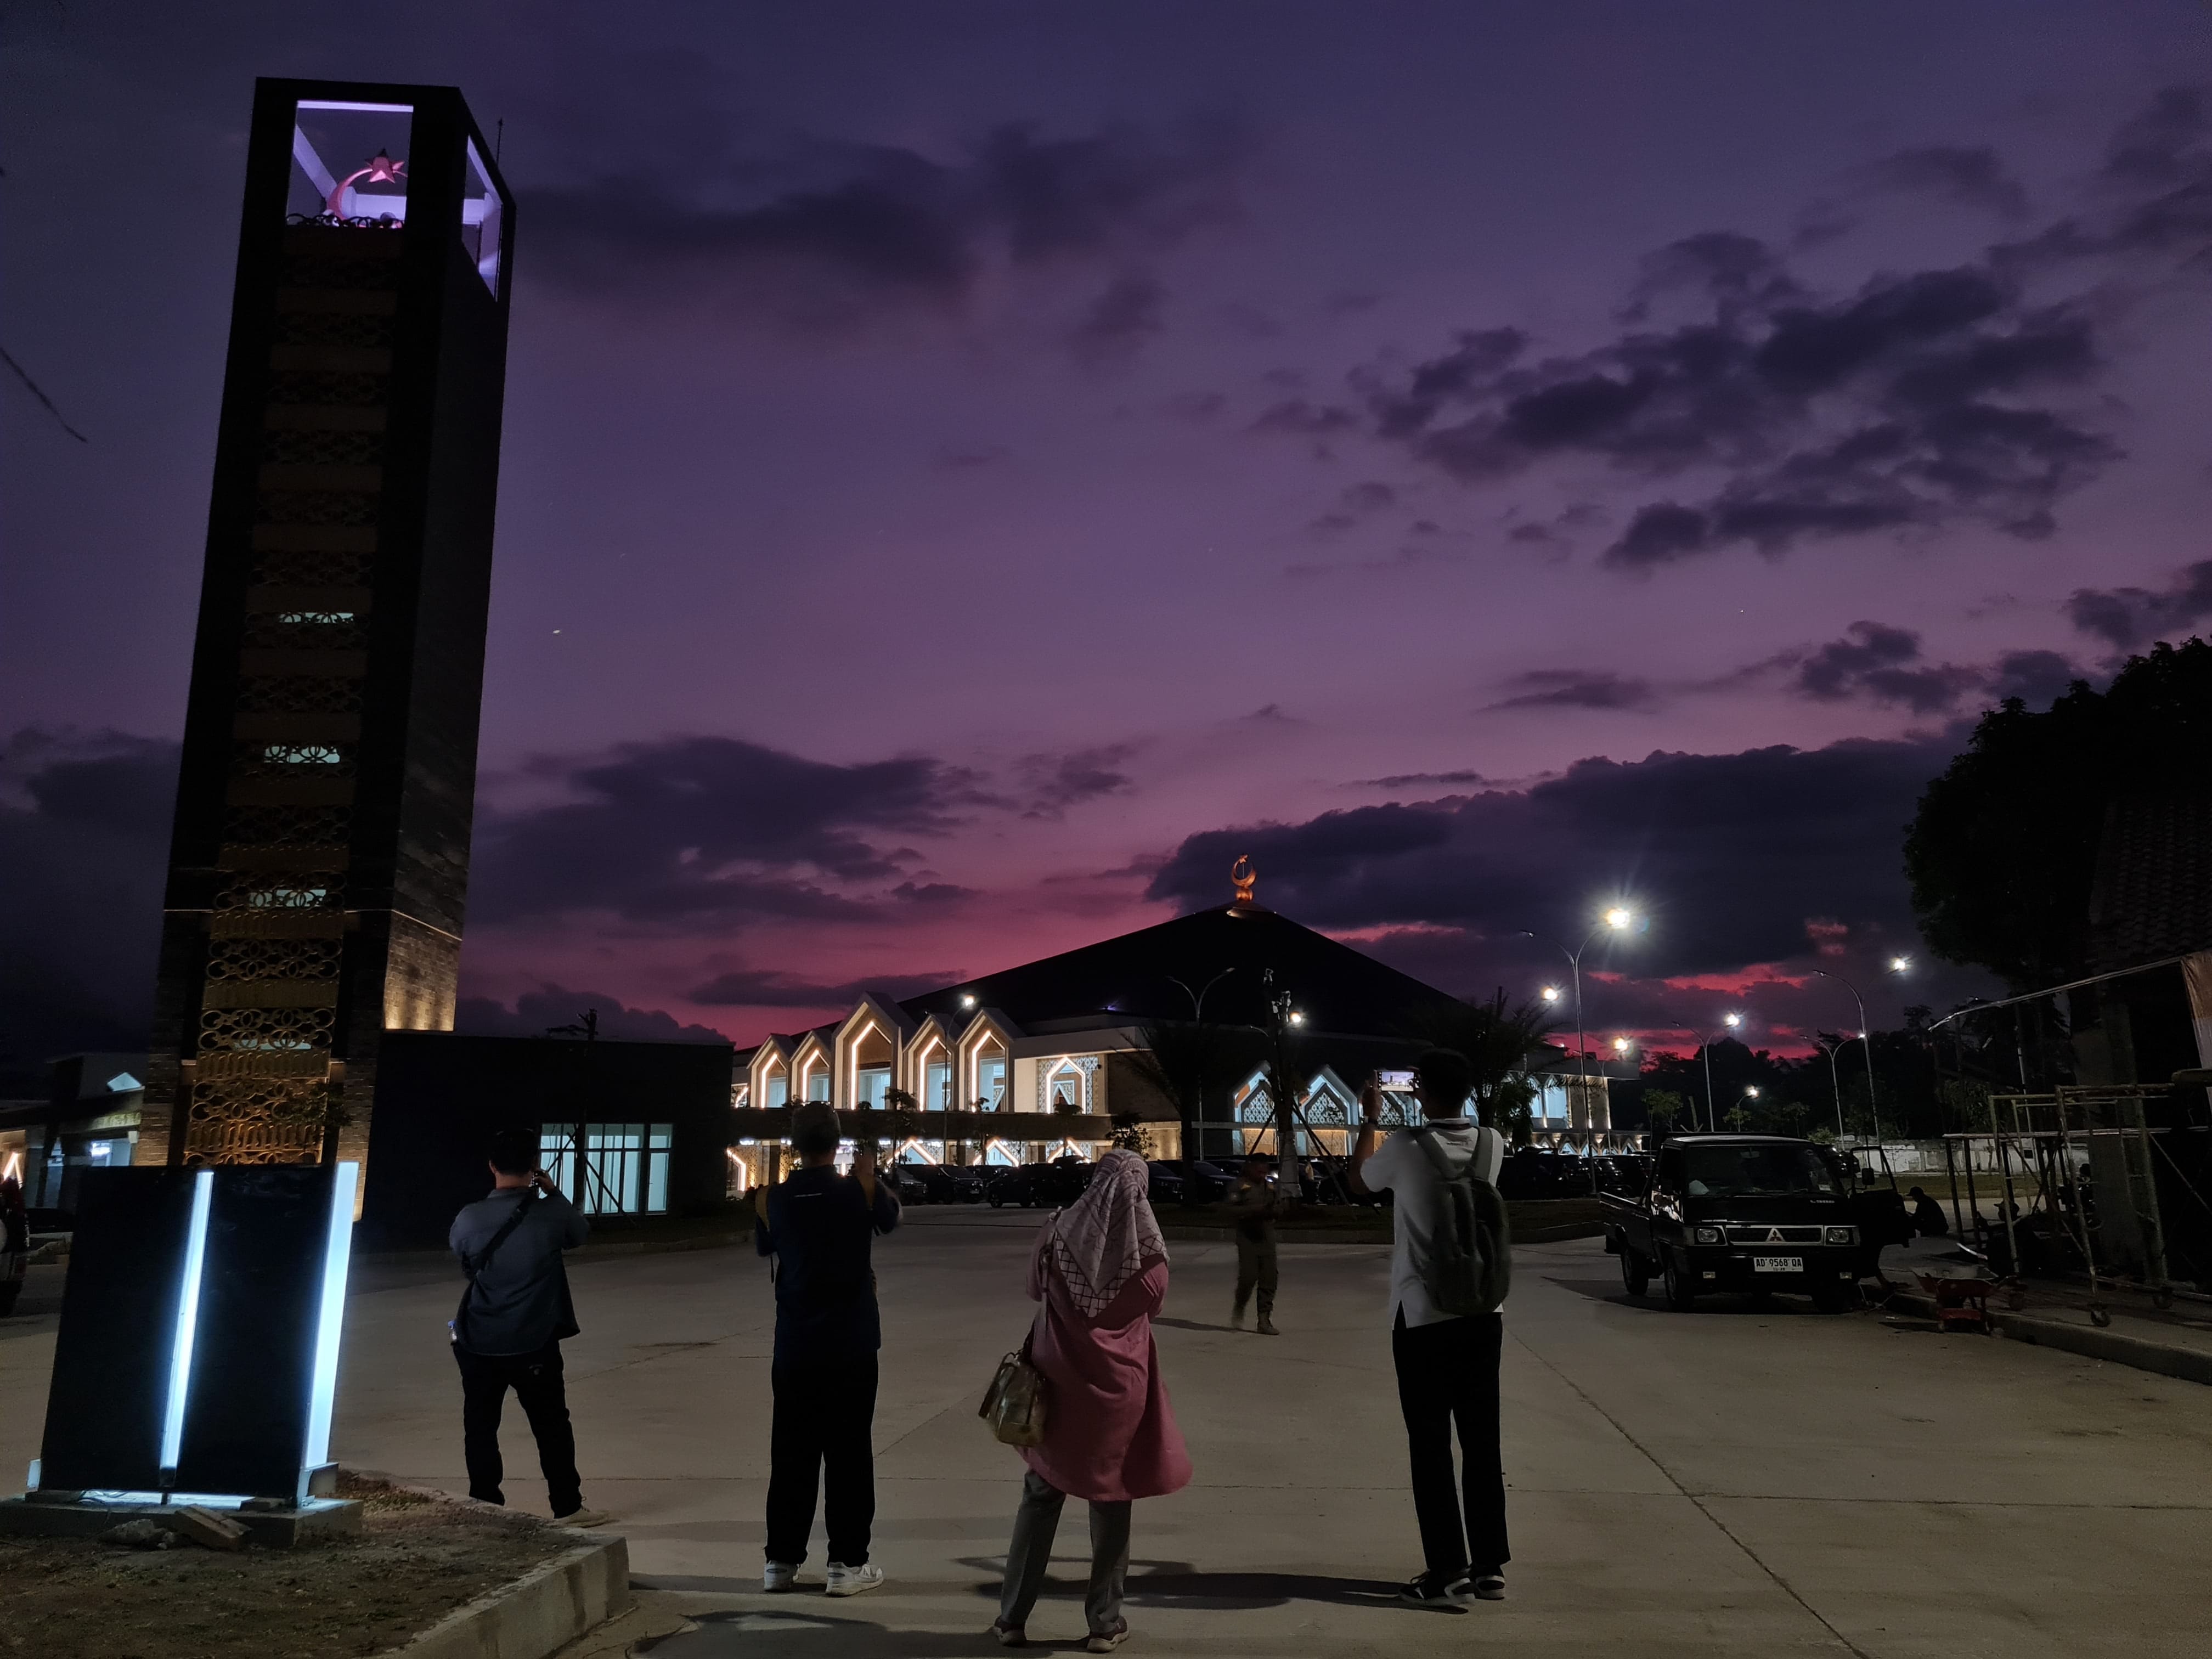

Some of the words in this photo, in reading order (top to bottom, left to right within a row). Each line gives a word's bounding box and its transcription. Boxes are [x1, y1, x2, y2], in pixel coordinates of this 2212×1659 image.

[1756, 1259, 1765, 1267] AD
[1769, 1259, 1788, 1267] 9568
[1792, 1259, 1802, 1267] QA
